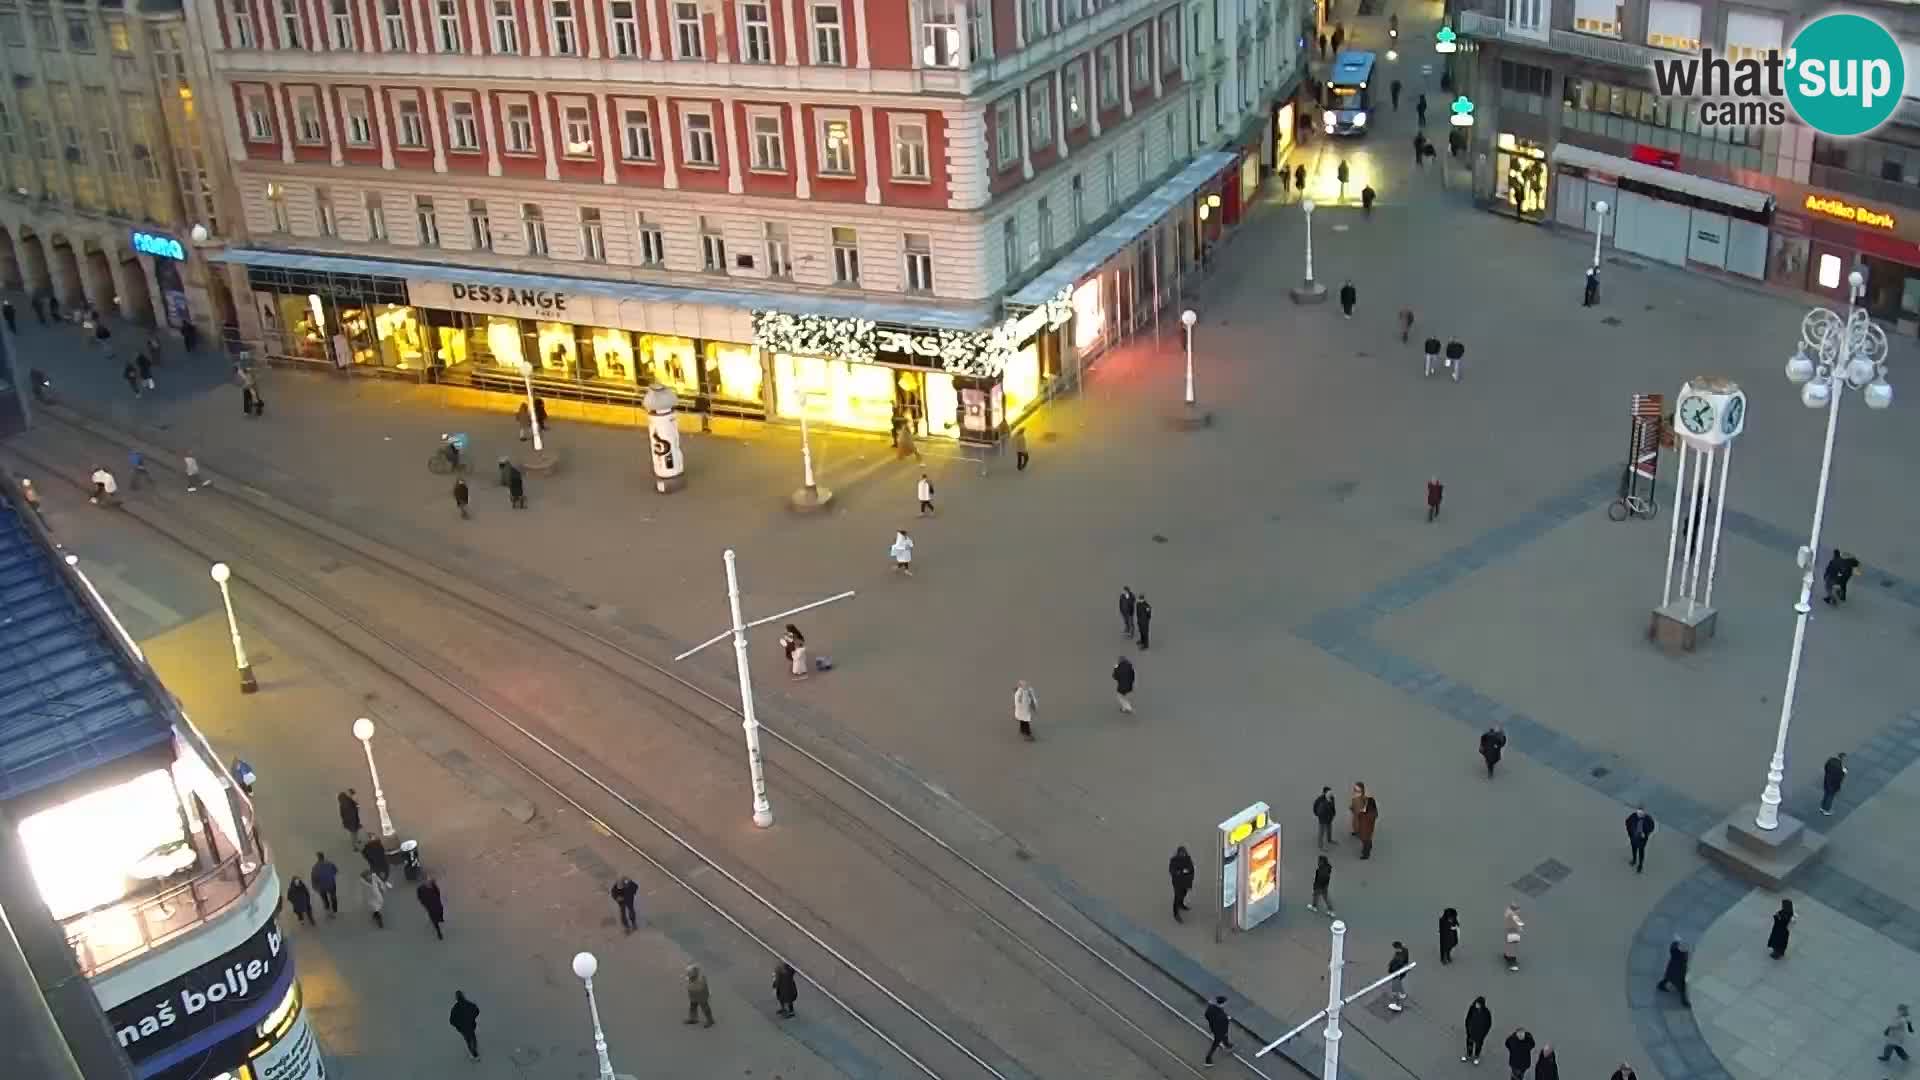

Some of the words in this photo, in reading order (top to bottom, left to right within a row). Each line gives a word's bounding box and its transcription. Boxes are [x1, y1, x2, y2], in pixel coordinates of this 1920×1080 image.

[1806, 195, 1856, 220] Addiko
[1857, 207, 1895, 230] Bank
[452, 282, 567, 311] DESSANGE
[116, 998, 177, 1048] naš
